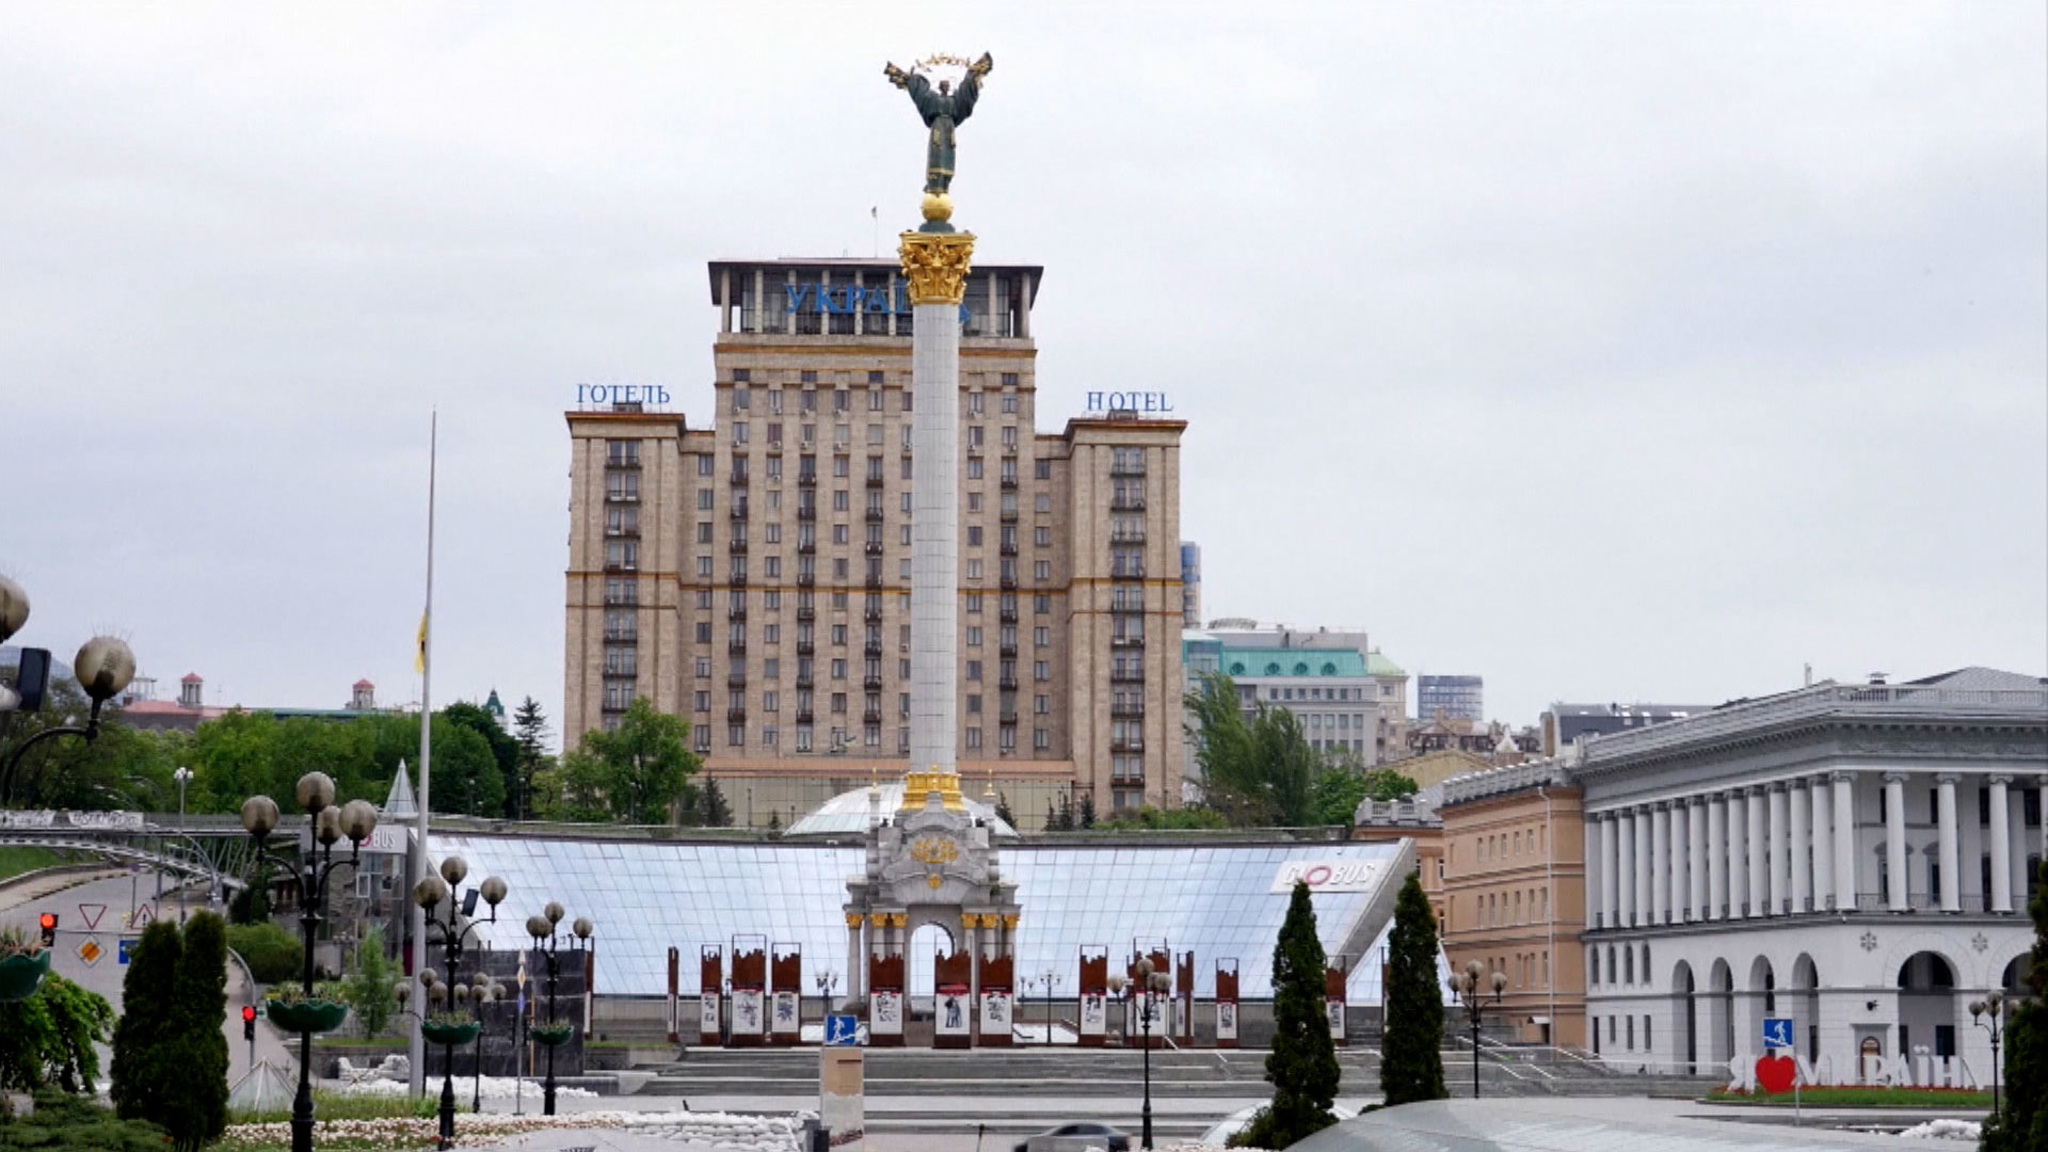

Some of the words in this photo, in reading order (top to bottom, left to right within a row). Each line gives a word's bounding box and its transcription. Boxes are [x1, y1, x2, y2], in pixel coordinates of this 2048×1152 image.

[784, 279, 973, 324] УКРАЇ
[576, 384, 670, 404] ГОТЕЛЬ
[1087, 391, 1174, 412] HOTEL
